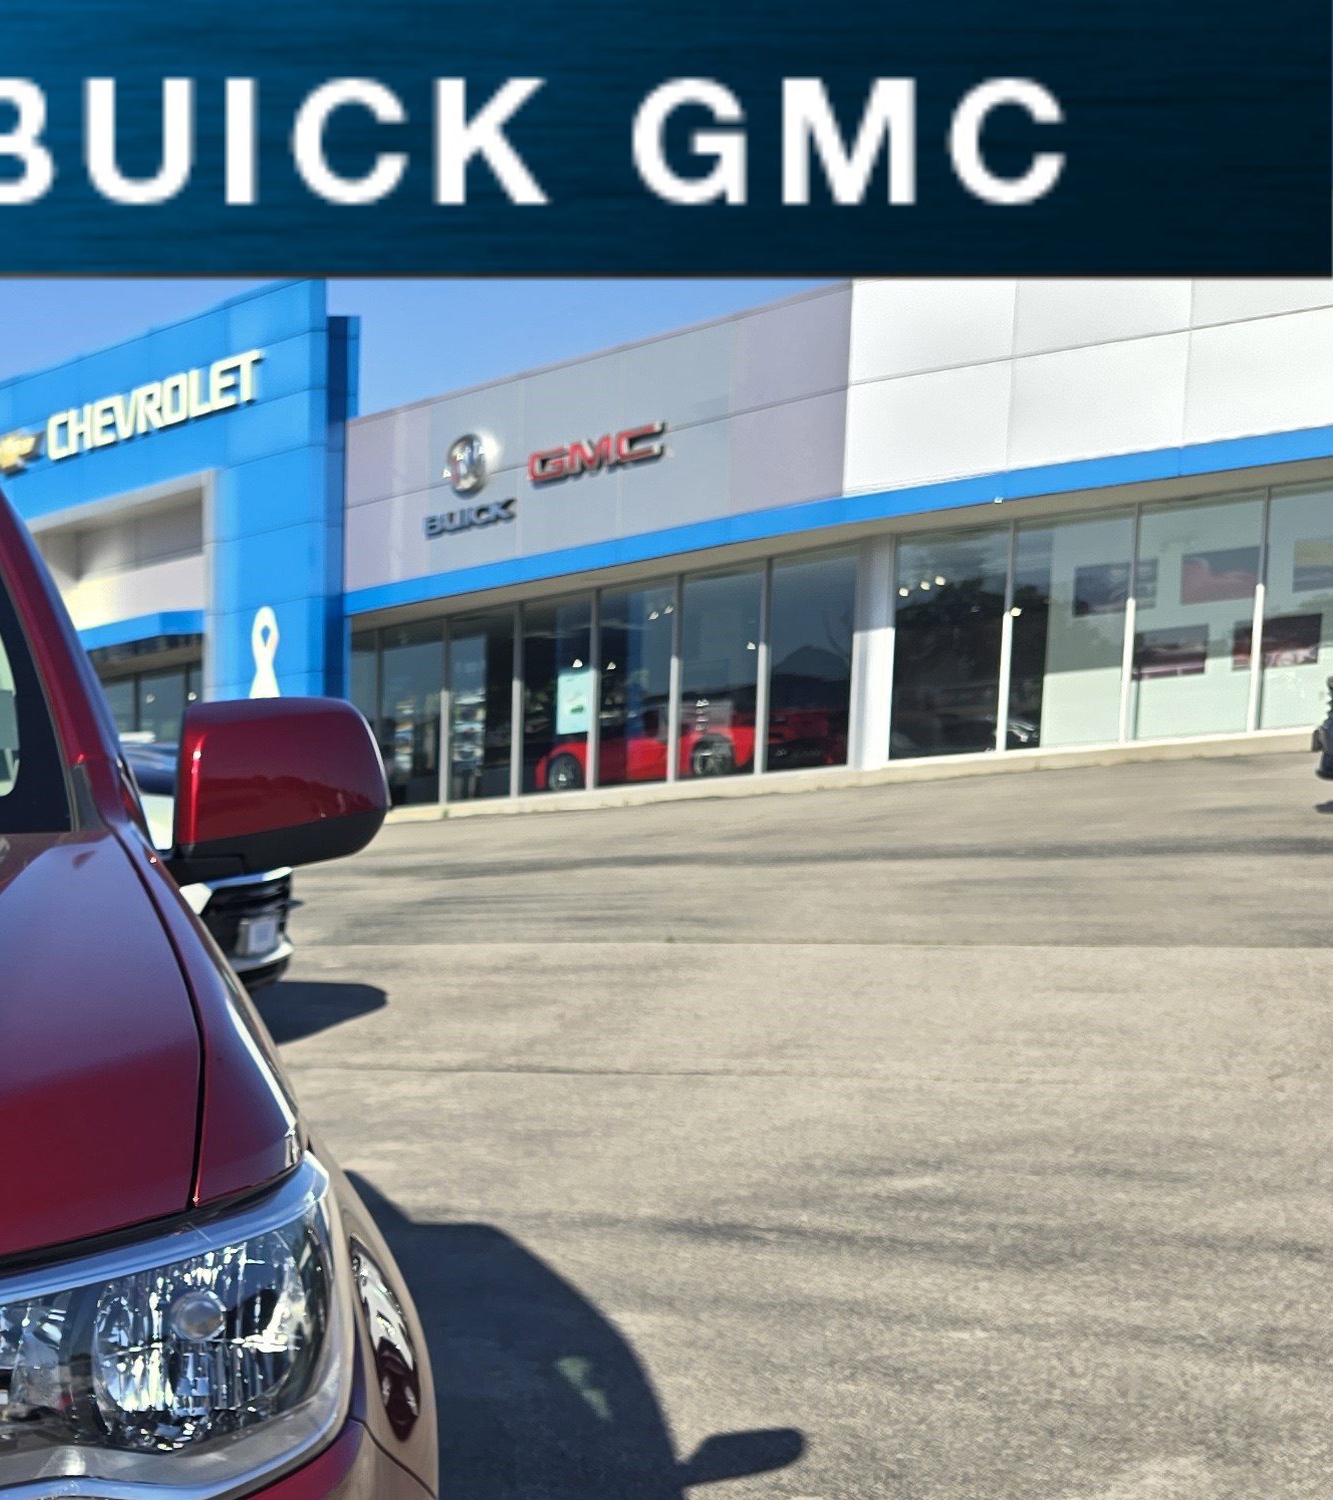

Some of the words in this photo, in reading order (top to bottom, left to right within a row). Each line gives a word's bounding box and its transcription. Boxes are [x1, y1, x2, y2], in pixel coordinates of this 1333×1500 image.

[47, 350, 261, 461] CHEVROLET
[528, 422, 664, 484] GMC
[424, 499, 516, 538] BUICK
